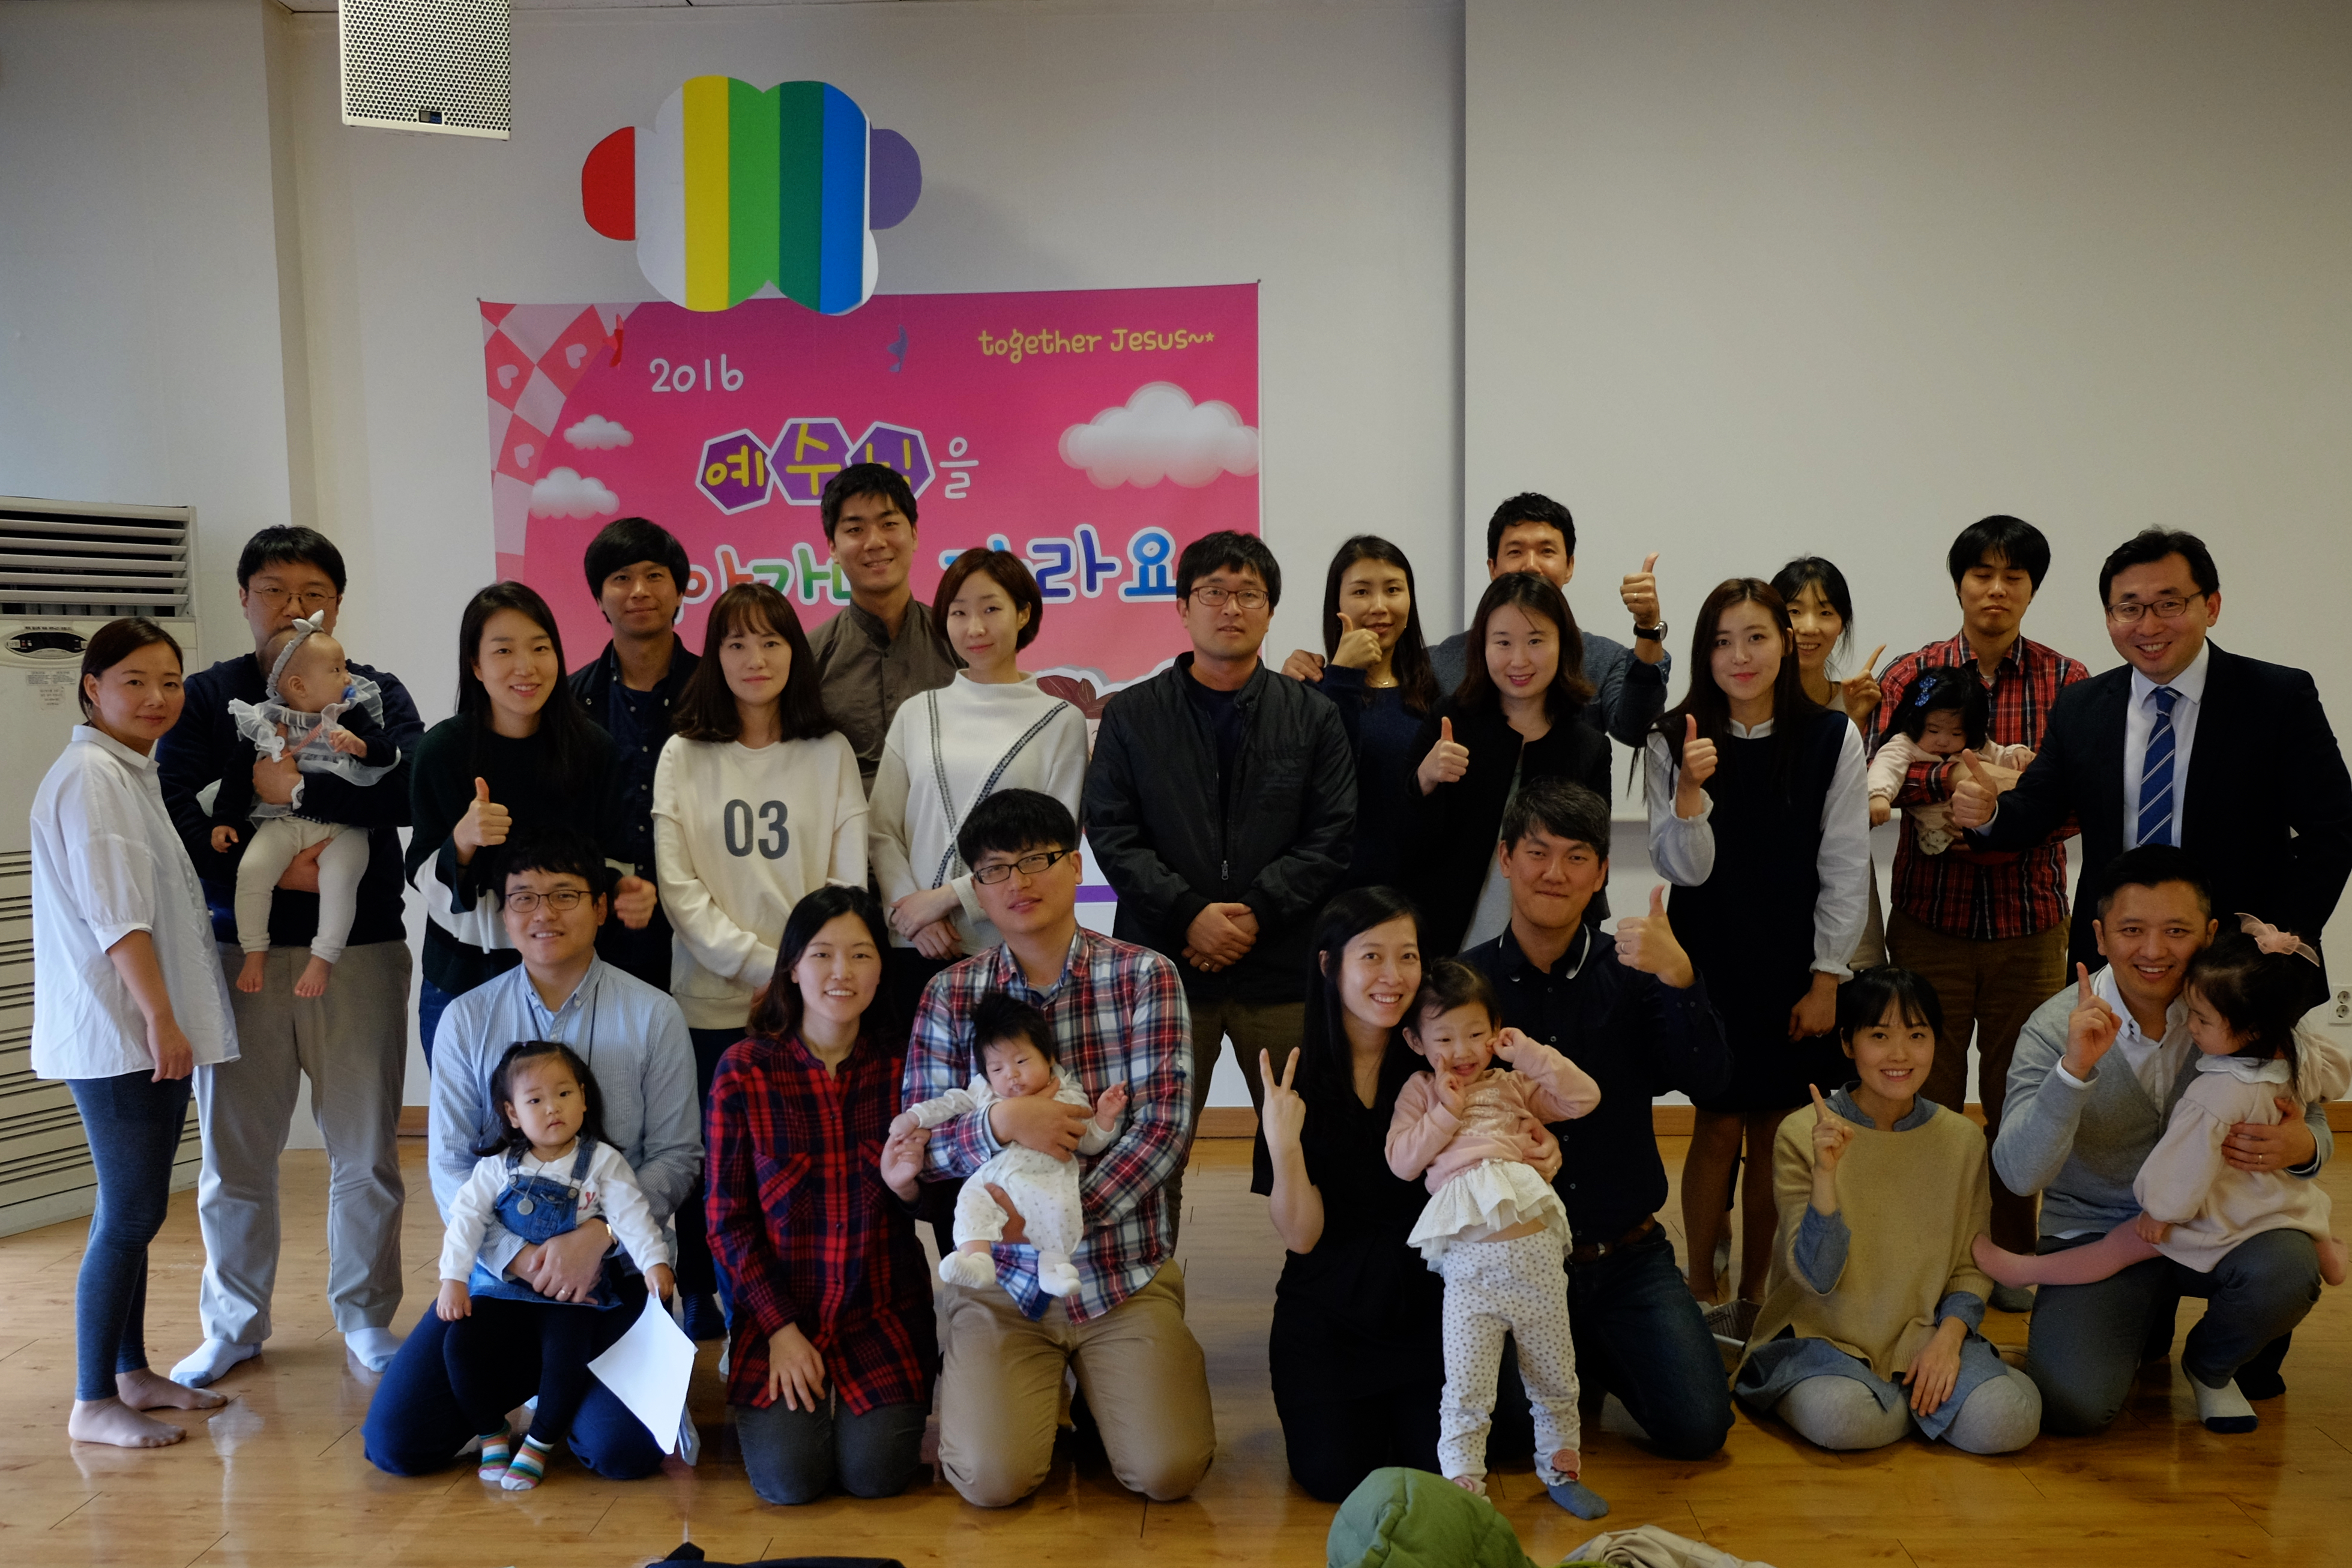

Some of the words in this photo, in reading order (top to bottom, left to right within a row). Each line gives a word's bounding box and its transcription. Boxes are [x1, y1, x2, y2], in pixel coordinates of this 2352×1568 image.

[978, 328, 1102, 364] together
[650, 354, 744, 392] 2016
[939, 524, 1177, 604] 라요
[724, 799, 789, 860] 03
